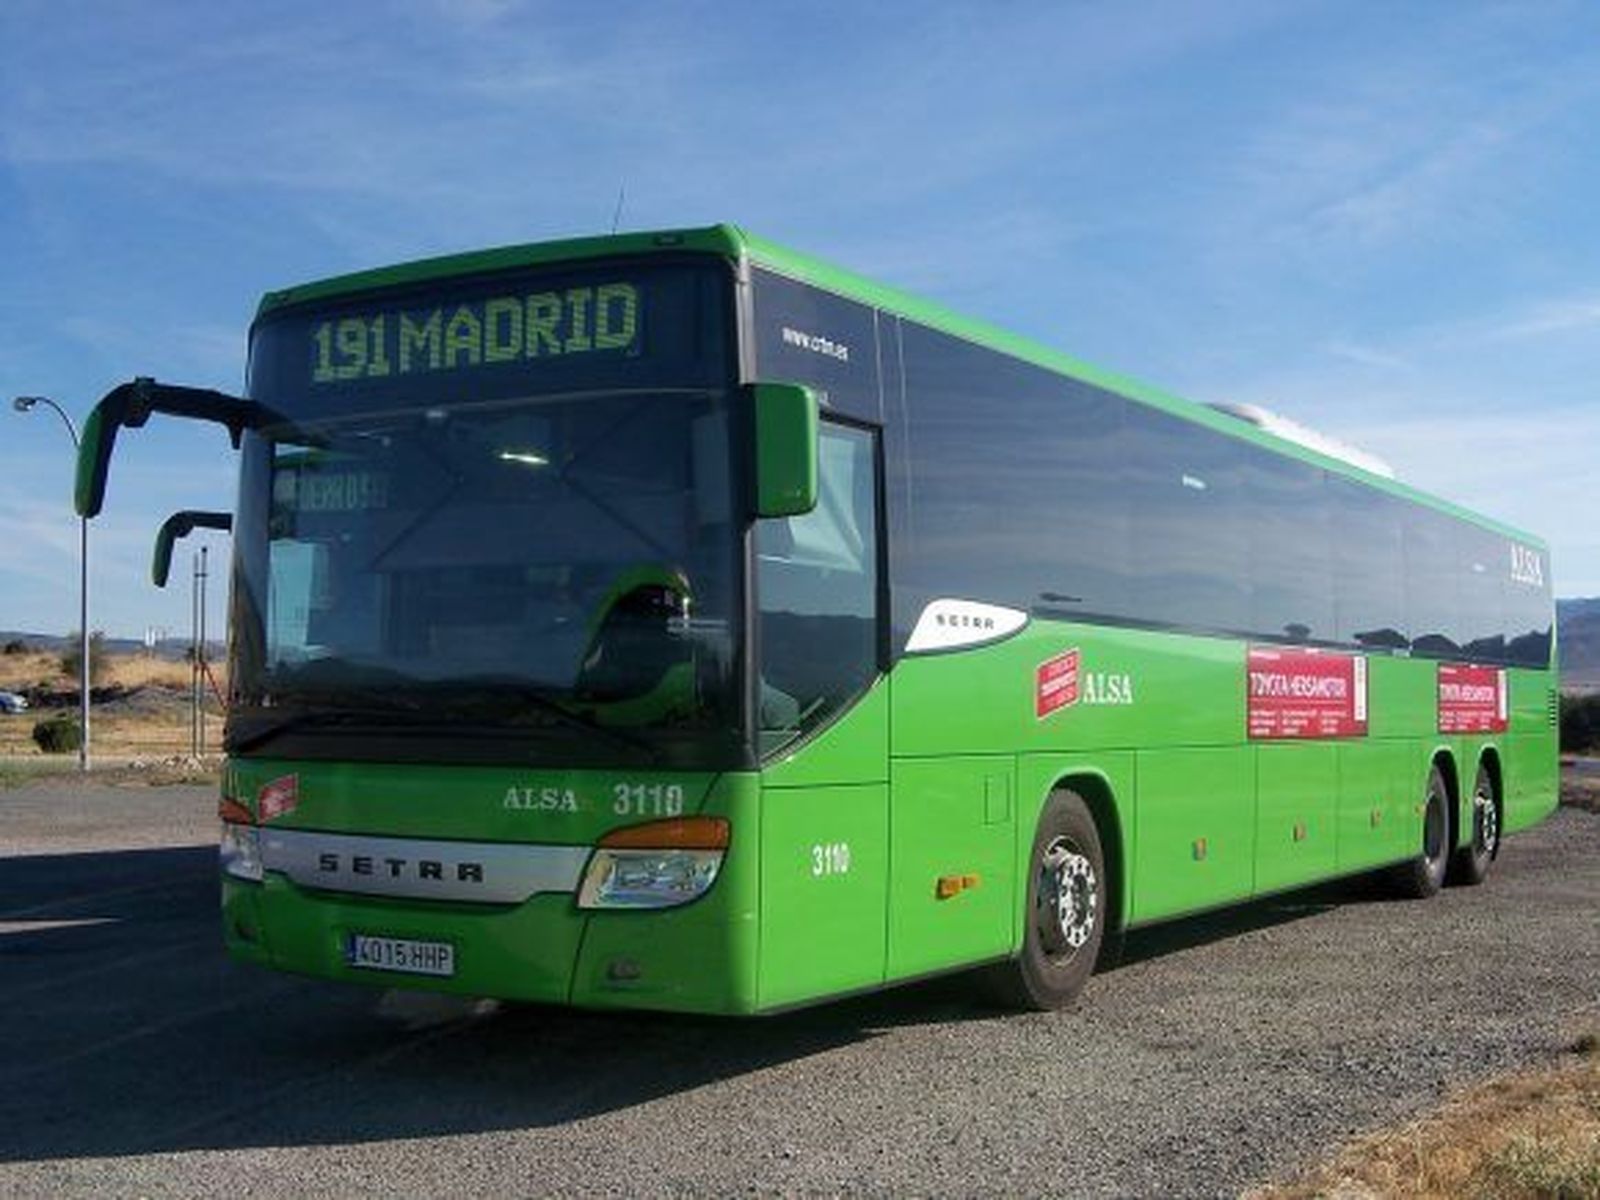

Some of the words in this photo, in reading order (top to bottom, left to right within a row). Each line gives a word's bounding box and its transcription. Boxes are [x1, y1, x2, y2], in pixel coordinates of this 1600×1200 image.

[312, 319, 389, 383] 191
[399, 283, 638, 372] MADRID
[1510, 543, 1543, 586] ALSA
[935, 614, 995, 630] SETRA
[1082, 673, 1133, 704] ALSA
[502, 786, 578, 813] ALSA
[612, 784, 684, 816] 3110
[318, 853, 485, 884] SETRA
[811, 842, 850, 875] 3110
